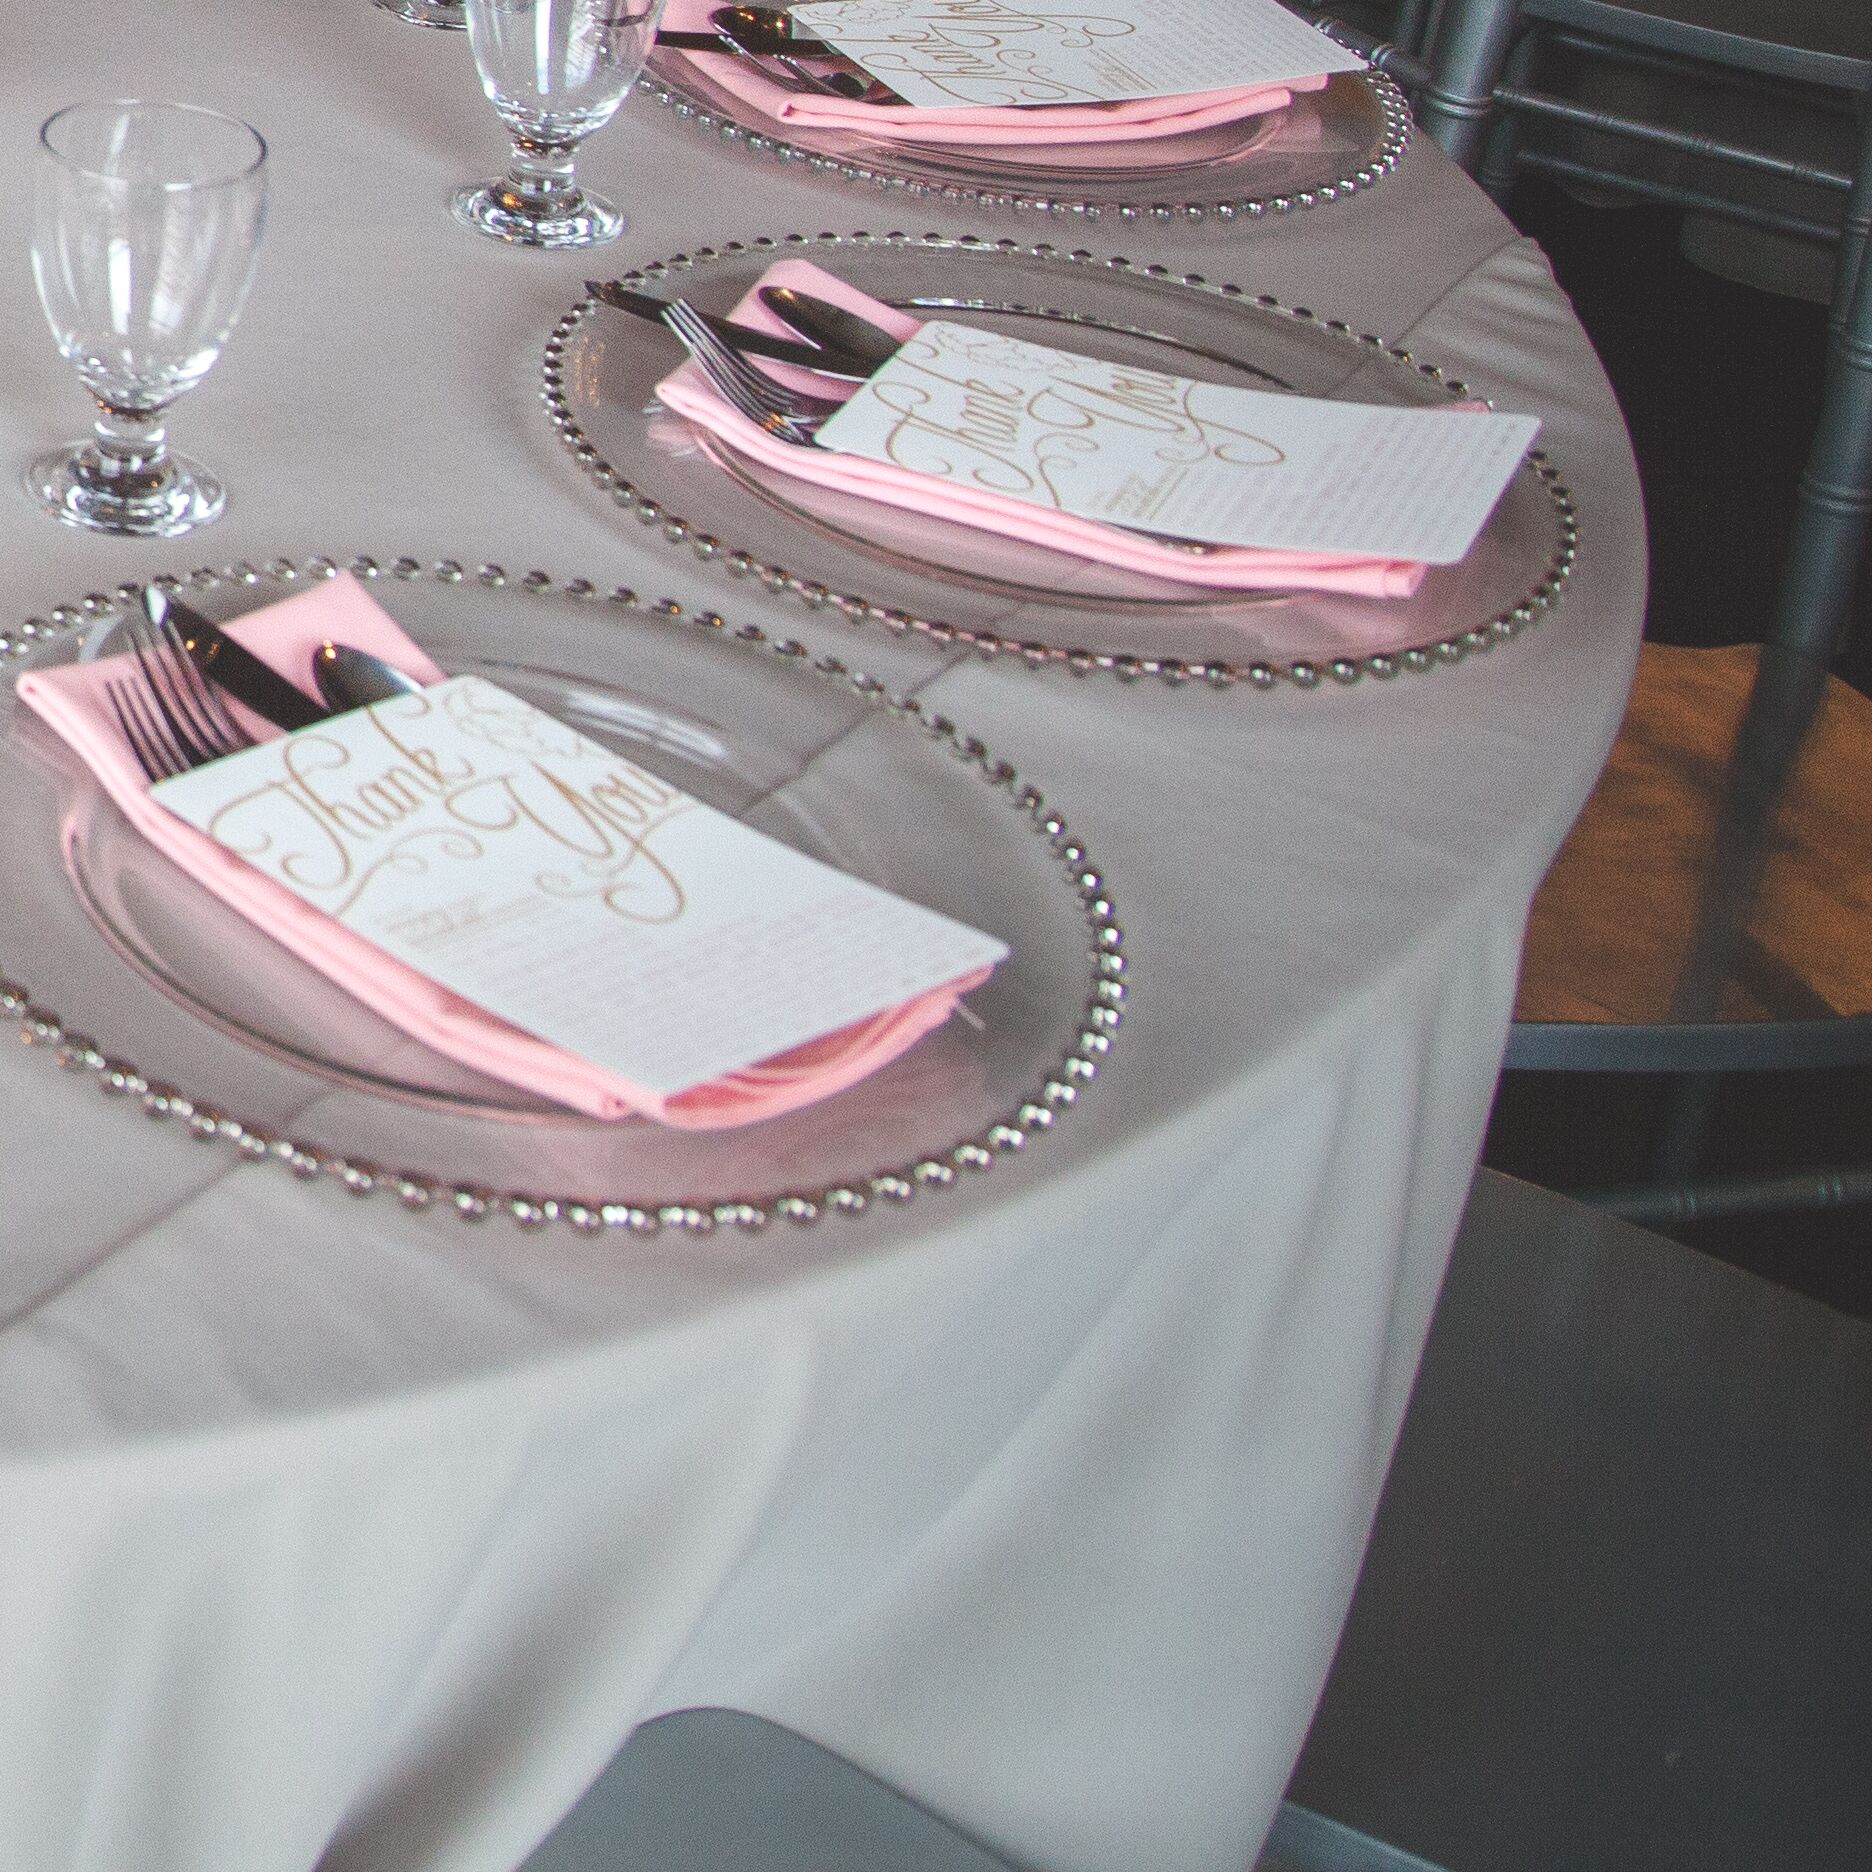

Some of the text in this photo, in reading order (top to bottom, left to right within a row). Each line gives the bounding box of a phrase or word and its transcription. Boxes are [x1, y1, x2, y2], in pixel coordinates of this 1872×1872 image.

[822, 30, 1068, 104] Thank
[872, 356, 1036, 493] Thank
[1028, 370, 1286, 467] You
[209, 707, 474, 887] Thank
[446, 762, 687, 924] You
